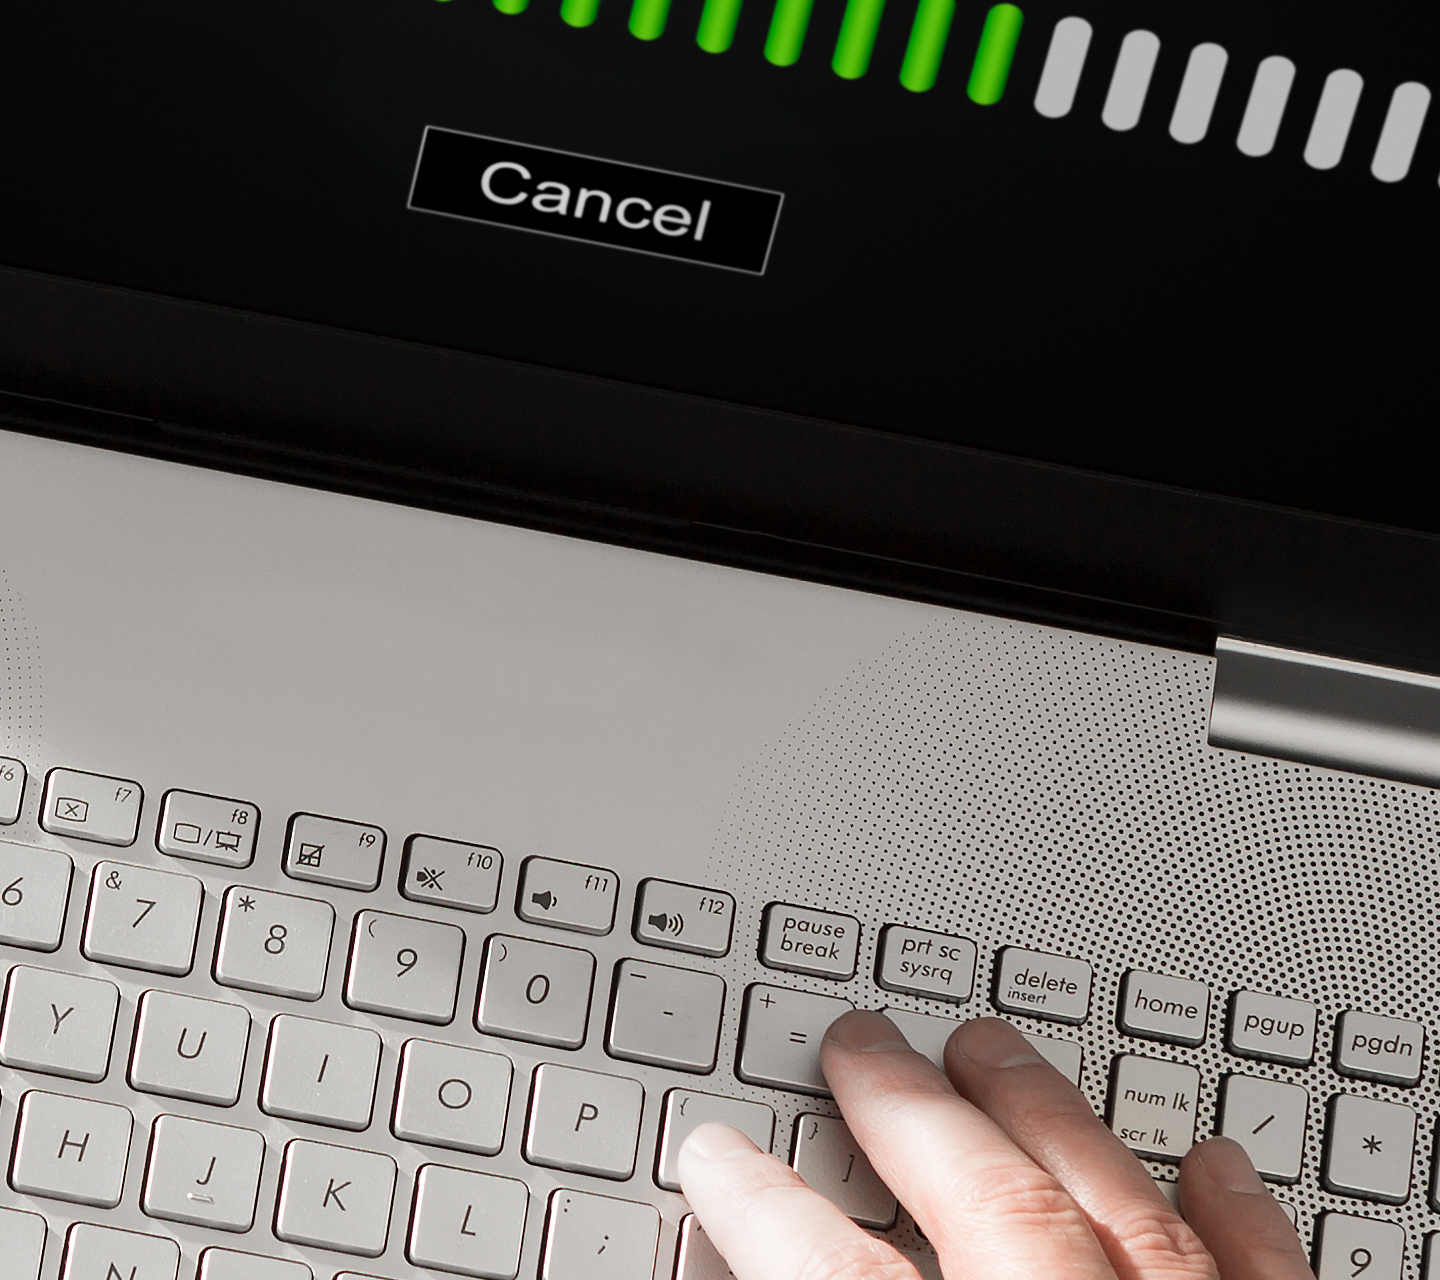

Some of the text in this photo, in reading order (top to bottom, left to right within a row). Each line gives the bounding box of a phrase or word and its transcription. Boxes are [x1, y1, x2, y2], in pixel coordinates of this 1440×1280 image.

[479, 160, 712, 243] Cancel
[0, 765, 13, 781] f6
[115, 788, 131, 802] f7
[232, 809, 248, 824] f8
[359, 833, 375, 847] f9
[468, 853, 492, 869] f10
[2, 877, 23, 905] 6
[586, 875, 608, 892] f11
[133, 899, 156, 928] 7
[700, 897, 724, 914] f12
[265, 925, 287, 954] 8
[782, 915, 846, 943] pause
[781, 930, 843, 959] break
[901, 939, 960, 960] prt sc
[397, 949, 417, 977] 9
[900, 962, 952, 985] sysrq
[526, 975, 549, 1004] 0
[1014, 968, 1079, 994] delete
[1008, 991, 1046, 1003] insert
[1135, 989, 1197, 1018] home
[52, 1004, 74, 1034] Y
[1244, 1015, 1304, 1040] pgup
[178, 1028, 206, 1058] U
[1352, 1035, 1412, 1056] pgdn
[318, 1055, 328, 1082] I
[439, 1079, 471, 1109] O
[1125, 1090, 1189, 1111] num lk
[575, 1103, 598, 1131] P
[58, 1130, 89, 1161] H
[1120, 1128, 1168, 1146] scr lk
[196, 1157, 216, 1185] J
[323, 1179, 351, 1211] K
[461, 1205, 475, 1236] L
[1351, 1249, 1371, 1277] 9
